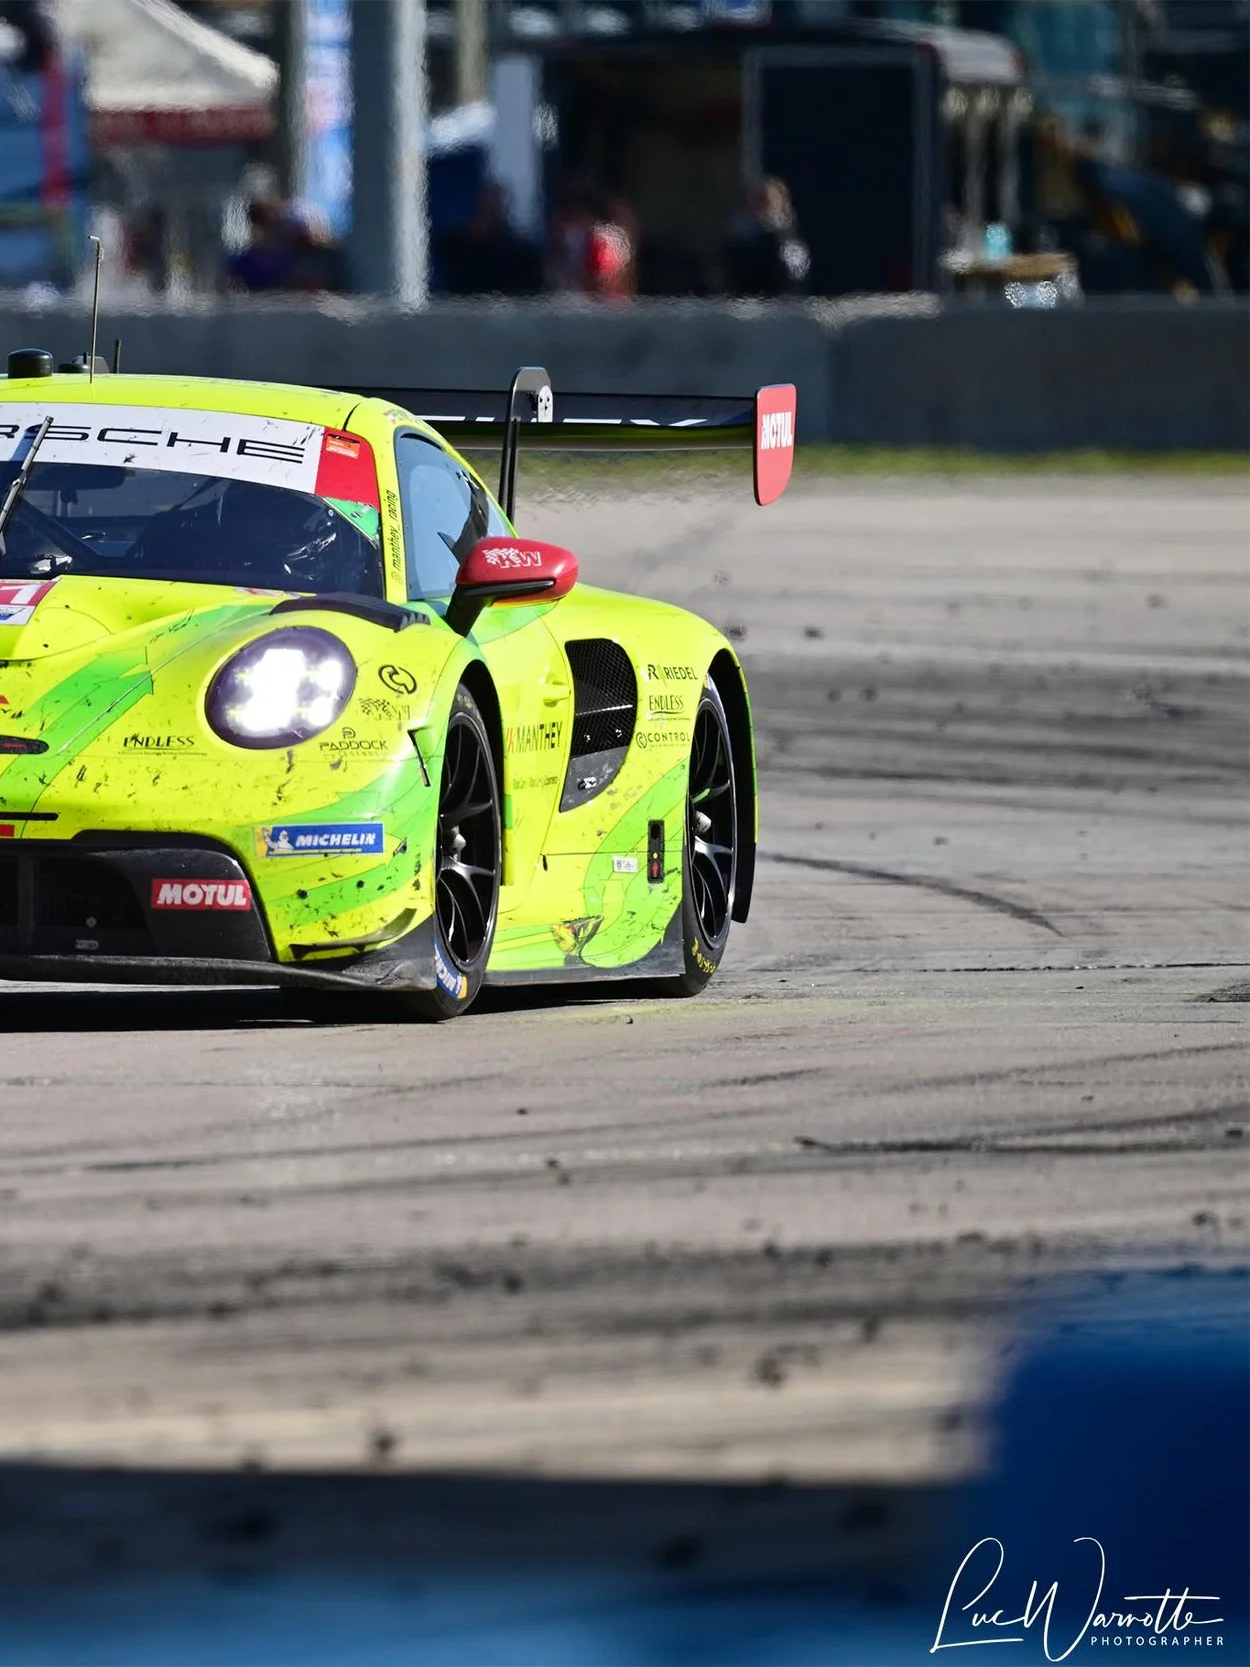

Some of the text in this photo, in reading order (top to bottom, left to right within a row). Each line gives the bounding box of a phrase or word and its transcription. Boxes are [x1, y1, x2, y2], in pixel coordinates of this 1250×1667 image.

[761, 411, 793, 450] MOTUL
[663, 666, 698, 680] RIEDEL
[649, 695, 684, 711] ENDLESS
[123, 735, 195, 748] ENDLESS
[516, 721, 562, 753] MANTHEY
[647, 732, 690, 743] CONTROL
[319, 740, 389, 751] PADDOCK
[295, 832, 376, 847] MICHELIN
[156, 883, 247, 906] MOTUL
